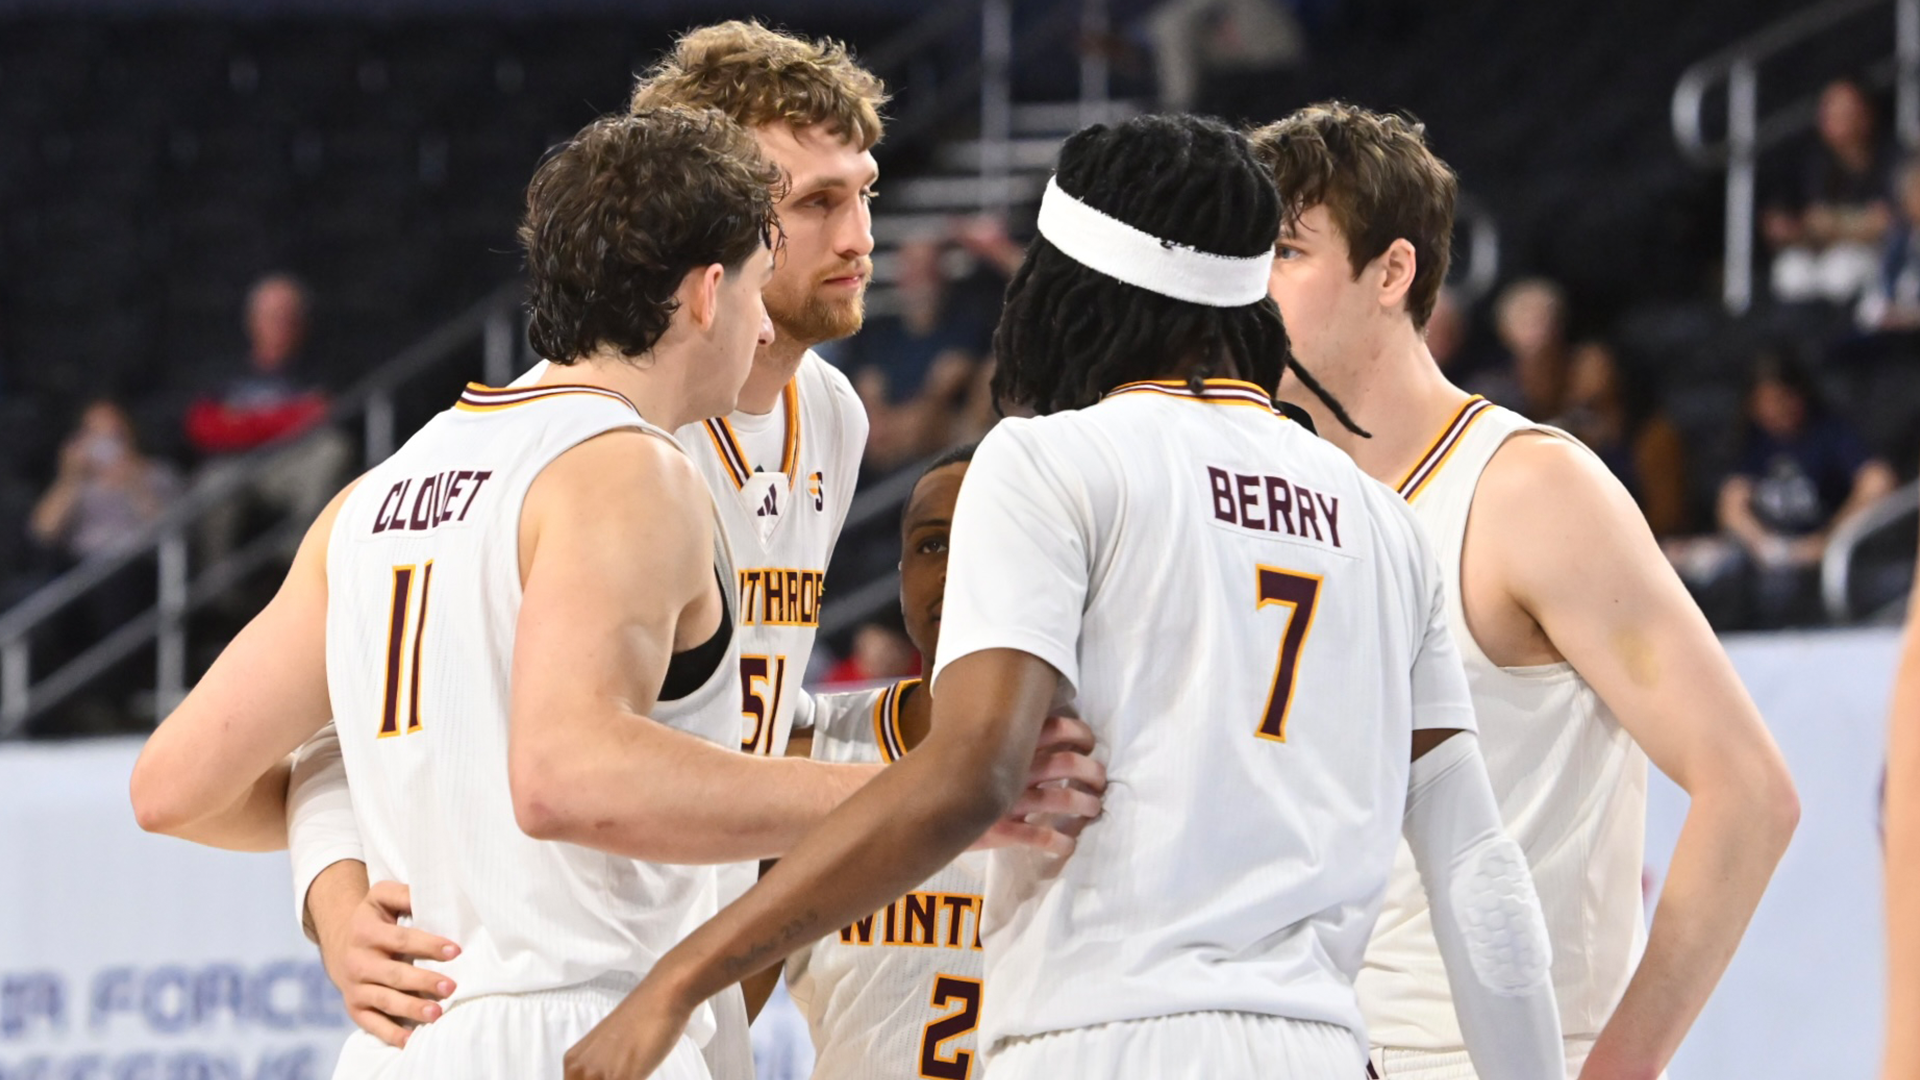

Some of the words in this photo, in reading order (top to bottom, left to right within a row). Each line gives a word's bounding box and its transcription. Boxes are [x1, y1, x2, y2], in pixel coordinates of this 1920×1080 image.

[372, 469, 493, 534] CLOUET
[1206, 465, 1342, 549] BERRY
[376, 558, 435, 739] 11
[1254, 563, 1324, 743] 7
[740, 654, 786, 757] 51
[838, 891, 984, 951] WINT
[918, 972, 984, 1080] 2
